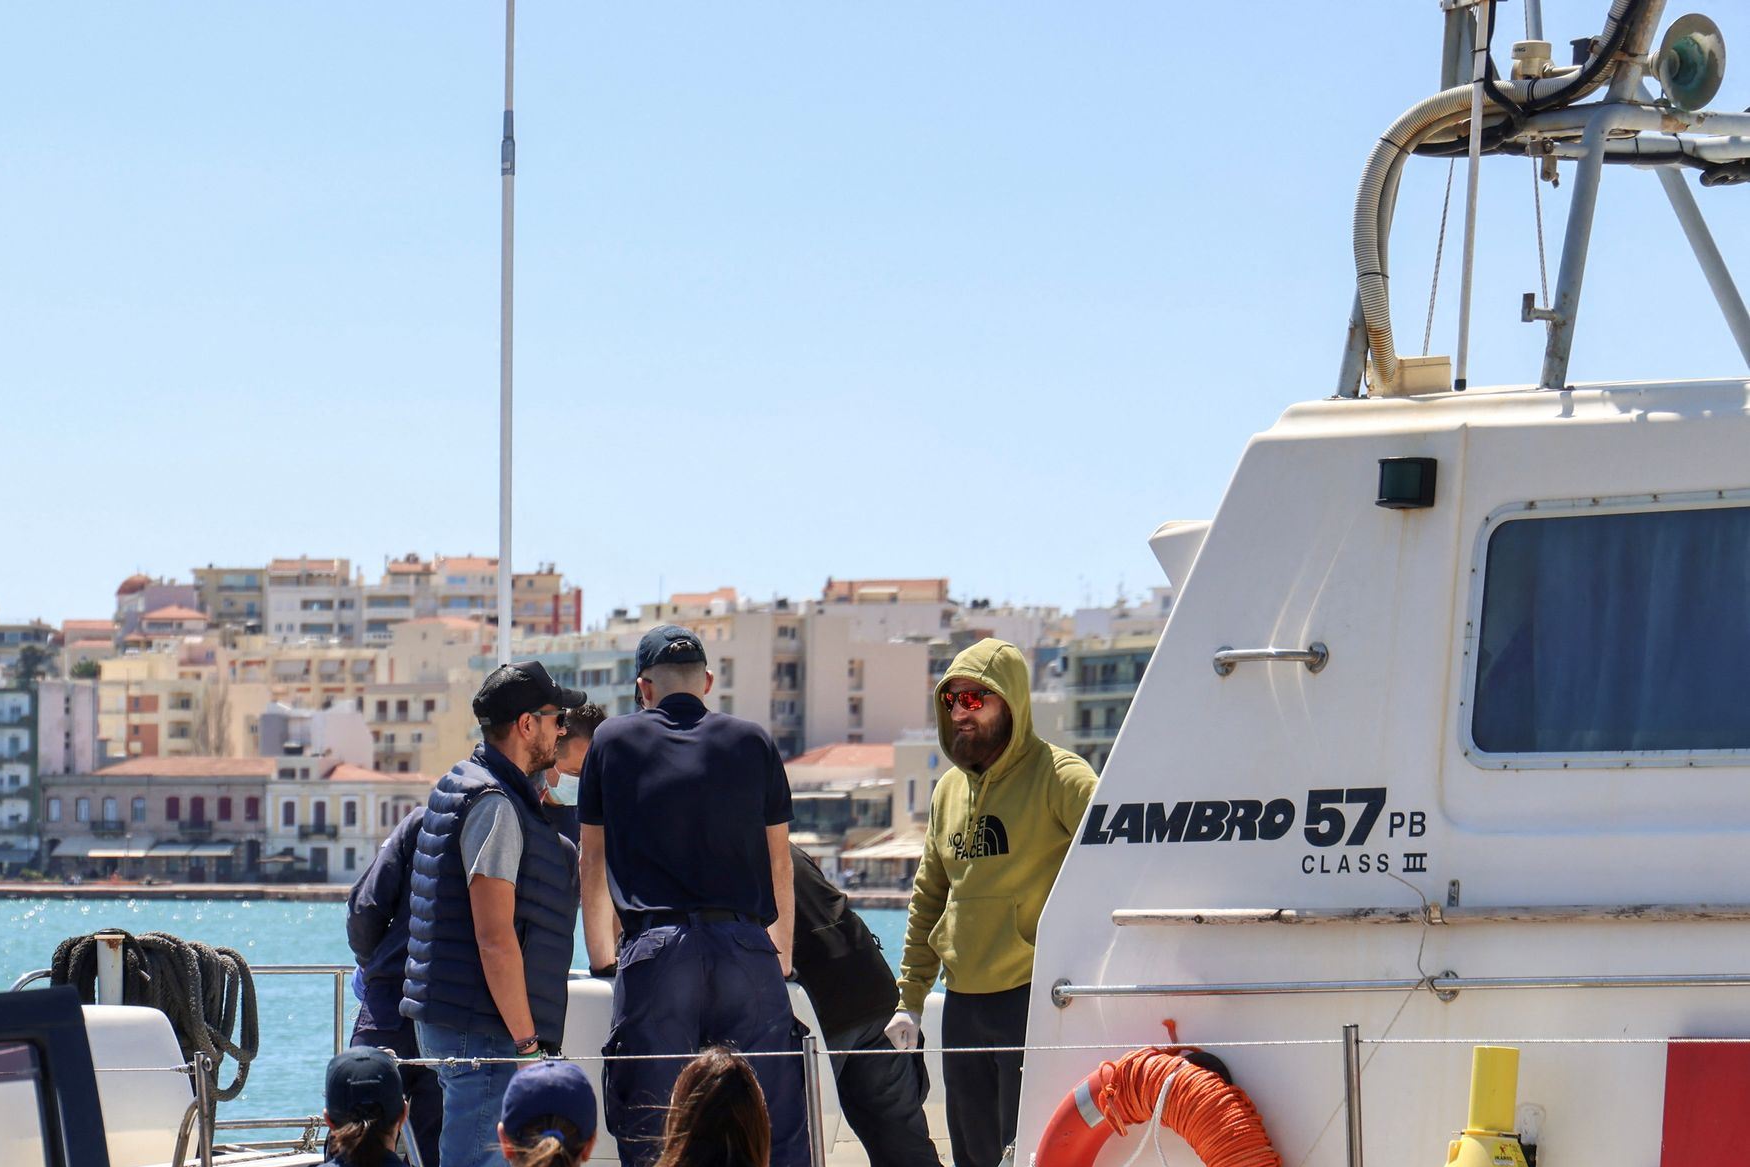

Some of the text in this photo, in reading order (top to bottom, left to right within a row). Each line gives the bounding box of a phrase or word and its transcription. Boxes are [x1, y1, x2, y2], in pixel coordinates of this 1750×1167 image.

[1080, 787, 1426, 847] LAMBRO 57 PB
[954, 843, 984, 860] FACE
[1301, 853, 1390, 874] CLASS
